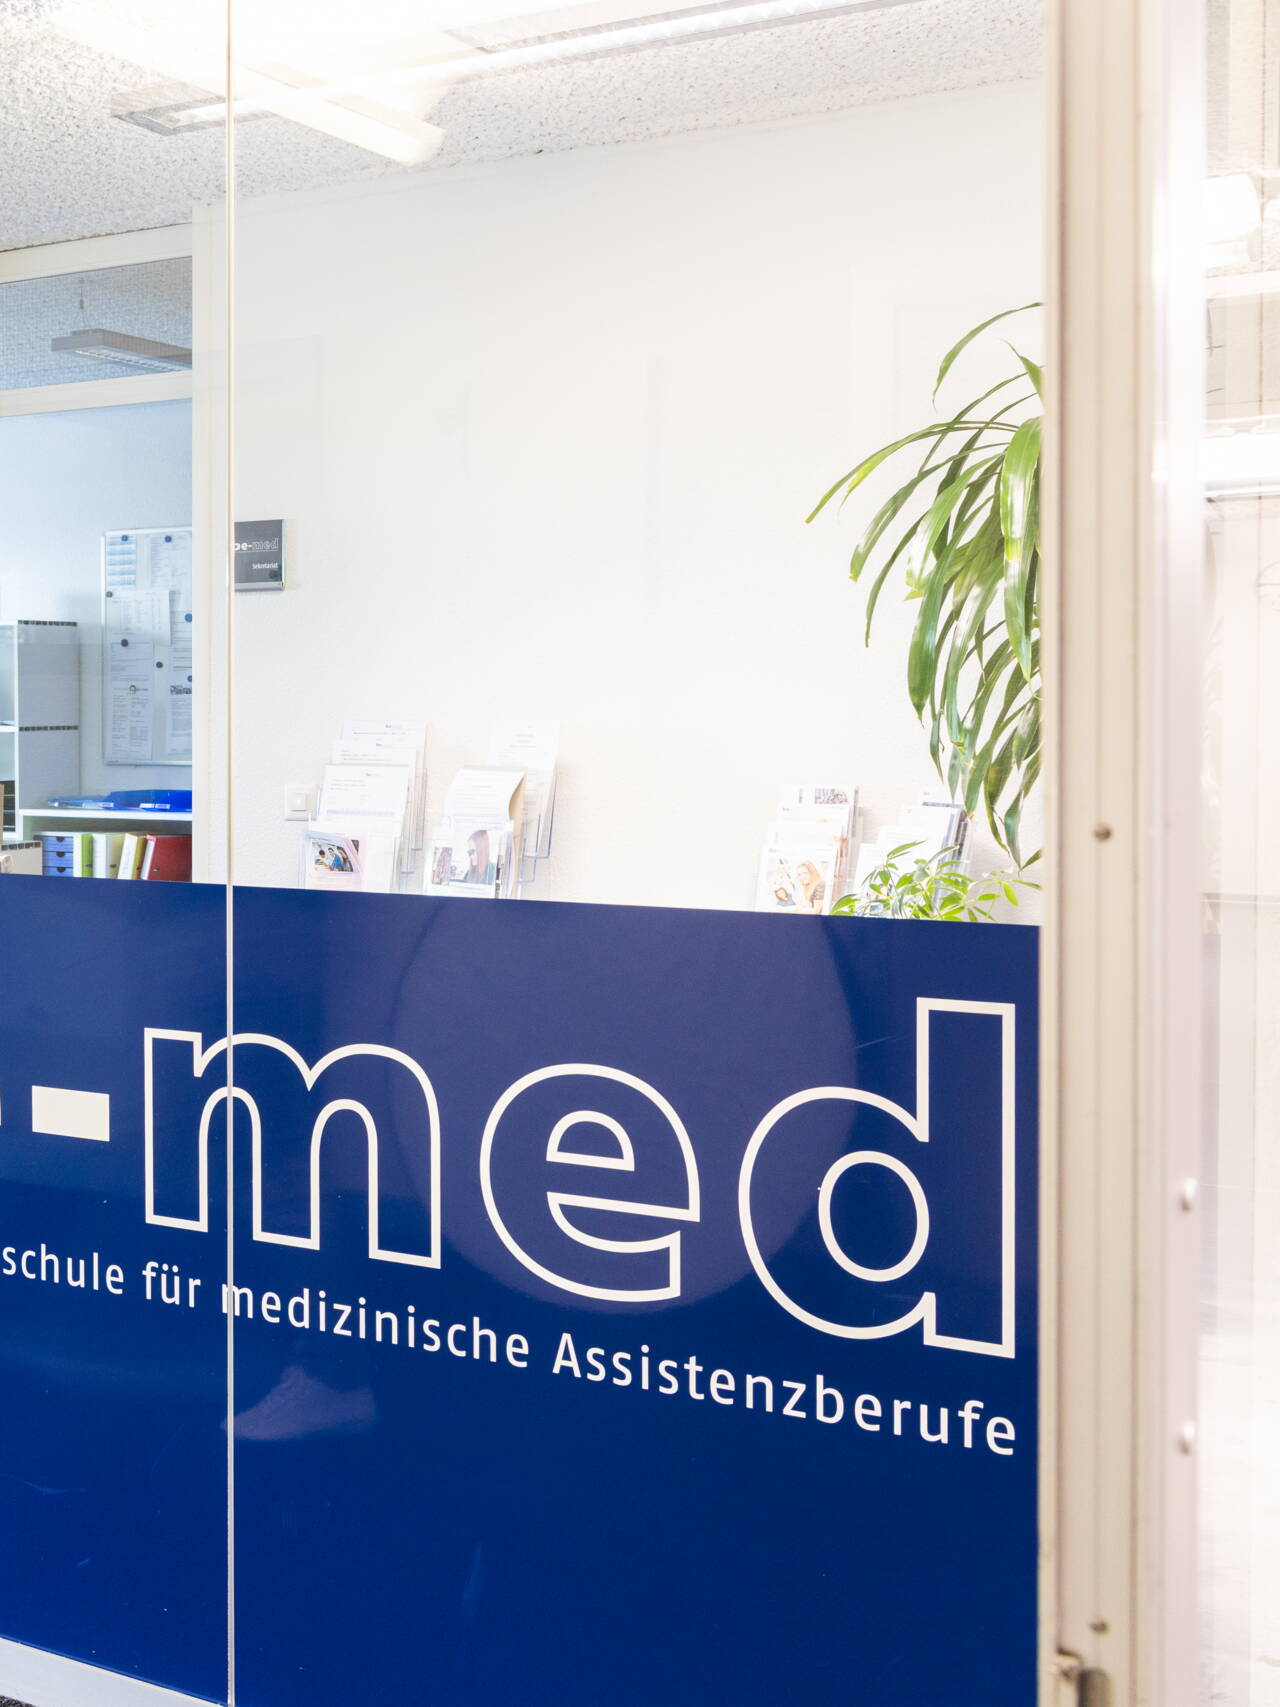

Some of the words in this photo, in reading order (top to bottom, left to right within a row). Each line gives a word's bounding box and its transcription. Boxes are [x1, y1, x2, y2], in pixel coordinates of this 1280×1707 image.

[142, 1261, 200, 1308] für
[221, 1283, 529, 1368] medizinische
[552, 1332, 1015, 1456] Assistenzberufe
